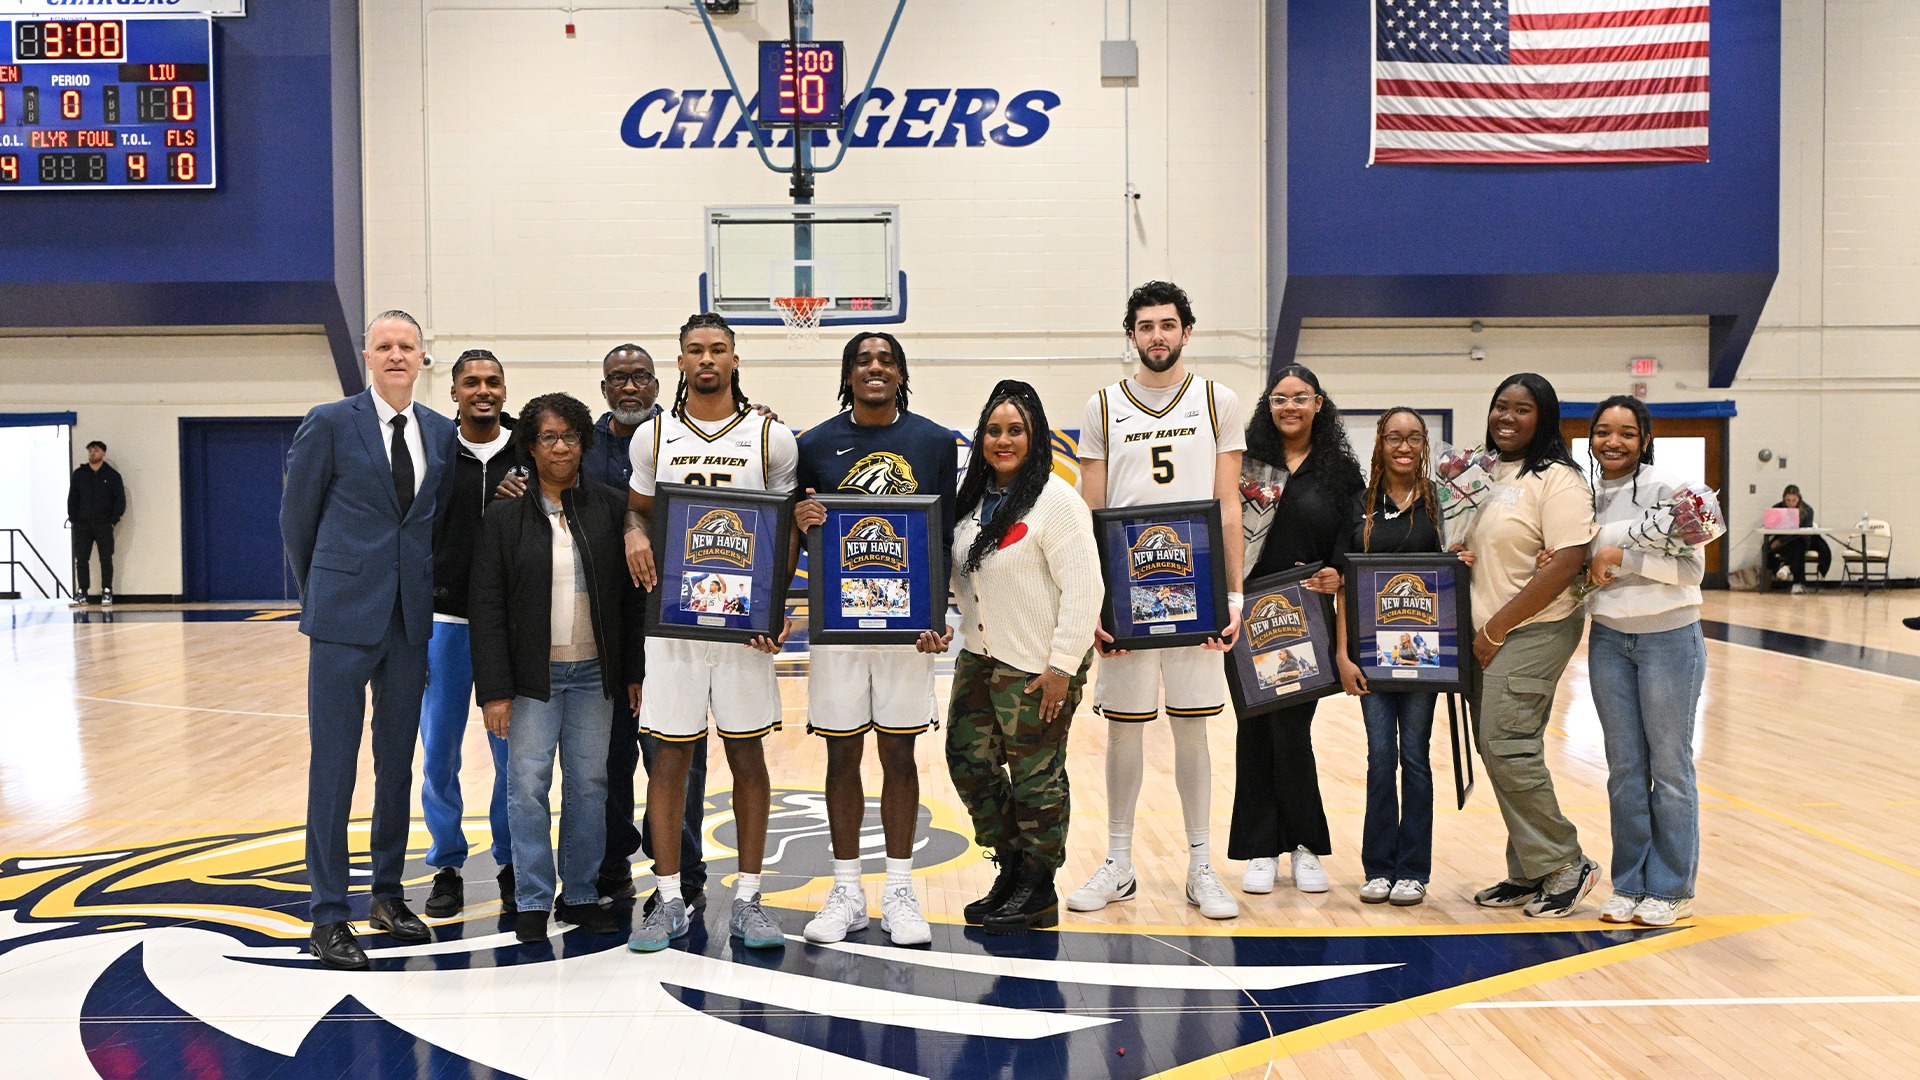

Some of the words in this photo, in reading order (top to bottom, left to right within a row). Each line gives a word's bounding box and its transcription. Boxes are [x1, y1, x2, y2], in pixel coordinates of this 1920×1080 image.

[44, 22, 119, 57] 3:00
[51, 75, 90, 86] PERIOD
[149, 64, 175, 81] LIU
[63, 90, 79, 118] 0
[31, 130, 68, 147] PLYR
[78, 130, 114, 147] FOUL
[121, 133, 152, 145] T.O.L.
[167, 130, 195, 146] FLS
[1, 156, 16, 179] 4
[128, 155, 145, 178] 4
[177, 152, 194, 180] 0
[1636, 359, 1654, 374] EXIT
[1124, 431, 1153, 443] NEW
[1155, 427, 1197, 439] HAVEN
[670, 456, 701, 466] NEW
[702, 456, 748, 467] HAVEN
[1150, 444, 1175, 486] 5
[692, 534, 714, 550] NEW
[716, 536, 748, 554] HAVEN
[847, 542, 868, 558] NEW
[871, 541, 902, 558] HAVEN
[698, 548, 741, 560] CHARGERS
[854, 554, 896, 564] CHARGERS
[1134, 550, 1154, 566] NEW
[1156, 548, 1187, 563] HAVEN
[1141, 561, 1181, 573] CHARGERS
[1381, 597, 1400, 612] NEW
[1403, 597, 1432, 612] HAVEN
[1387, 609, 1427, 619] CHARGERS
[1250, 620, 1270, 637] NEW
[1271, 611, 1301, 628] HAVEN
[1260, 626, 1298, 641] CHARGERS
